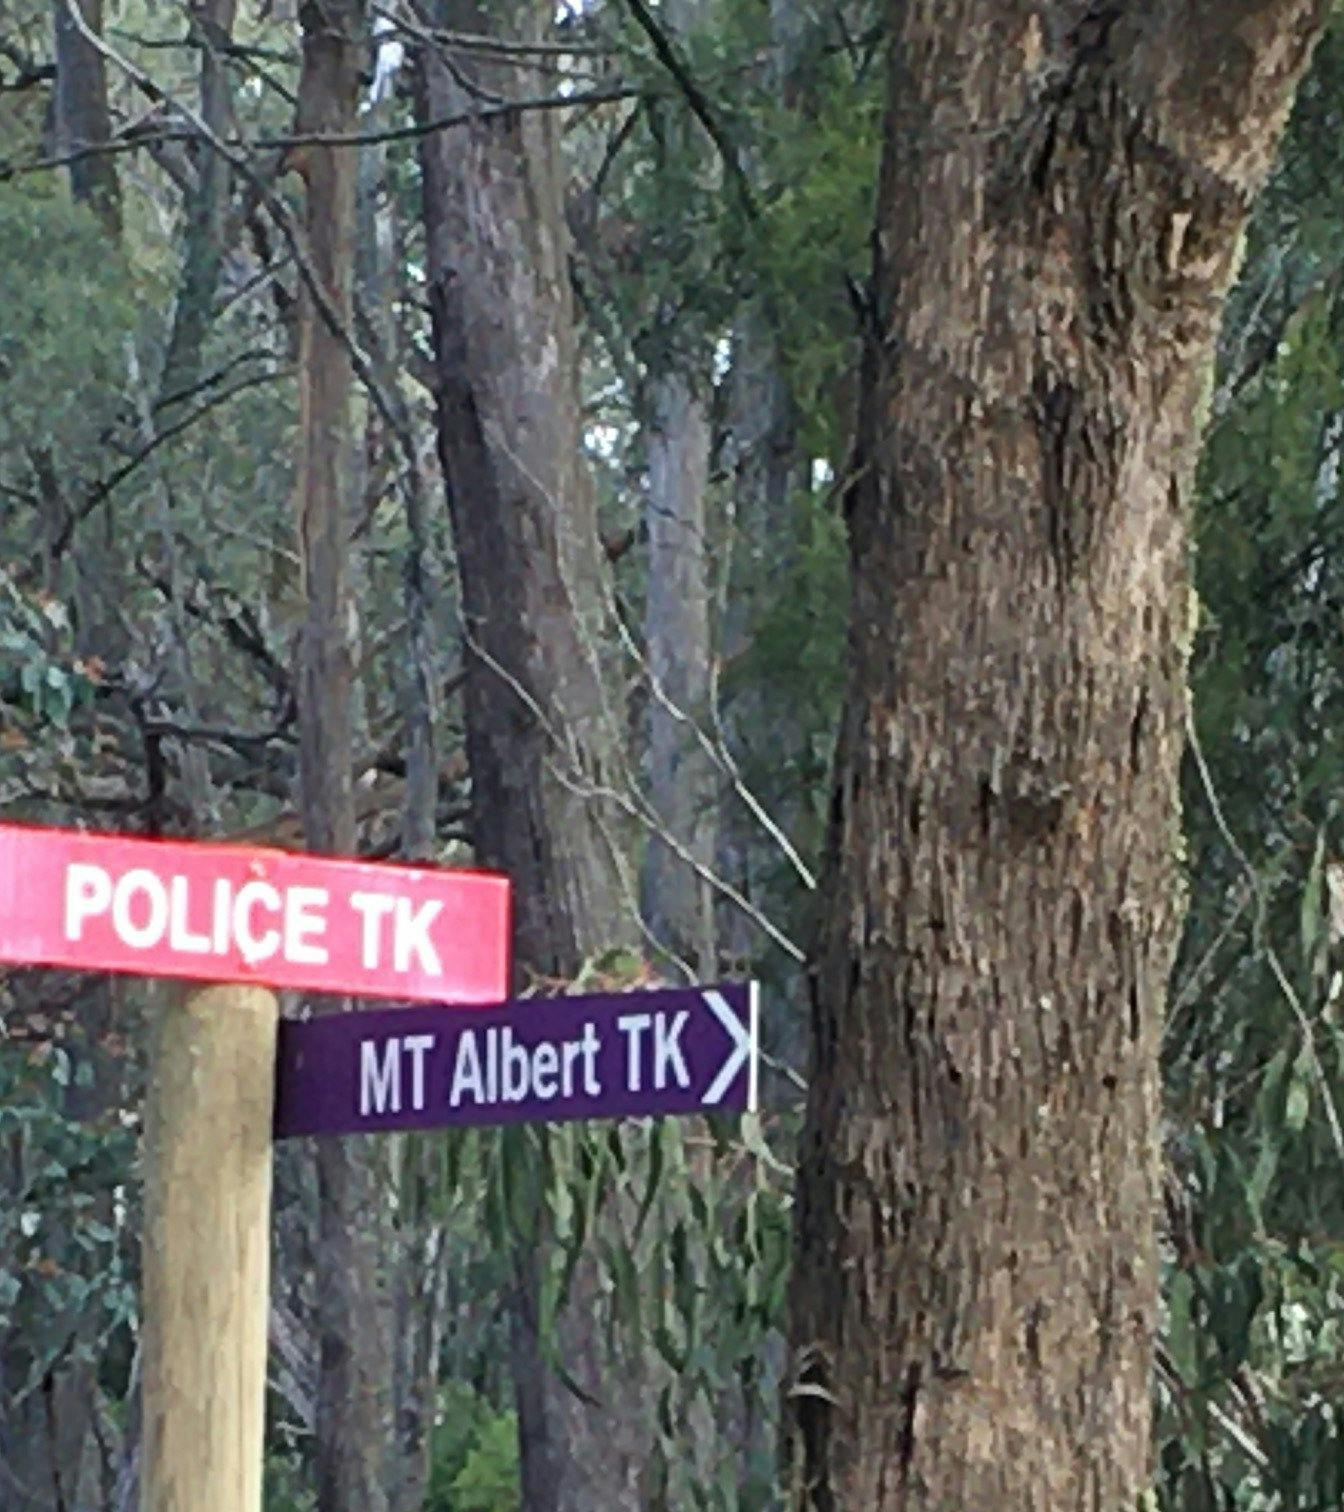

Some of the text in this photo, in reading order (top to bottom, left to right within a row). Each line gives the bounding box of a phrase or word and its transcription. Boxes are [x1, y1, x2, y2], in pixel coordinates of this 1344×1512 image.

[65, 864, 443, 975] POLICE TK
[360, 1012, 690, 1114] MT Albert TK
